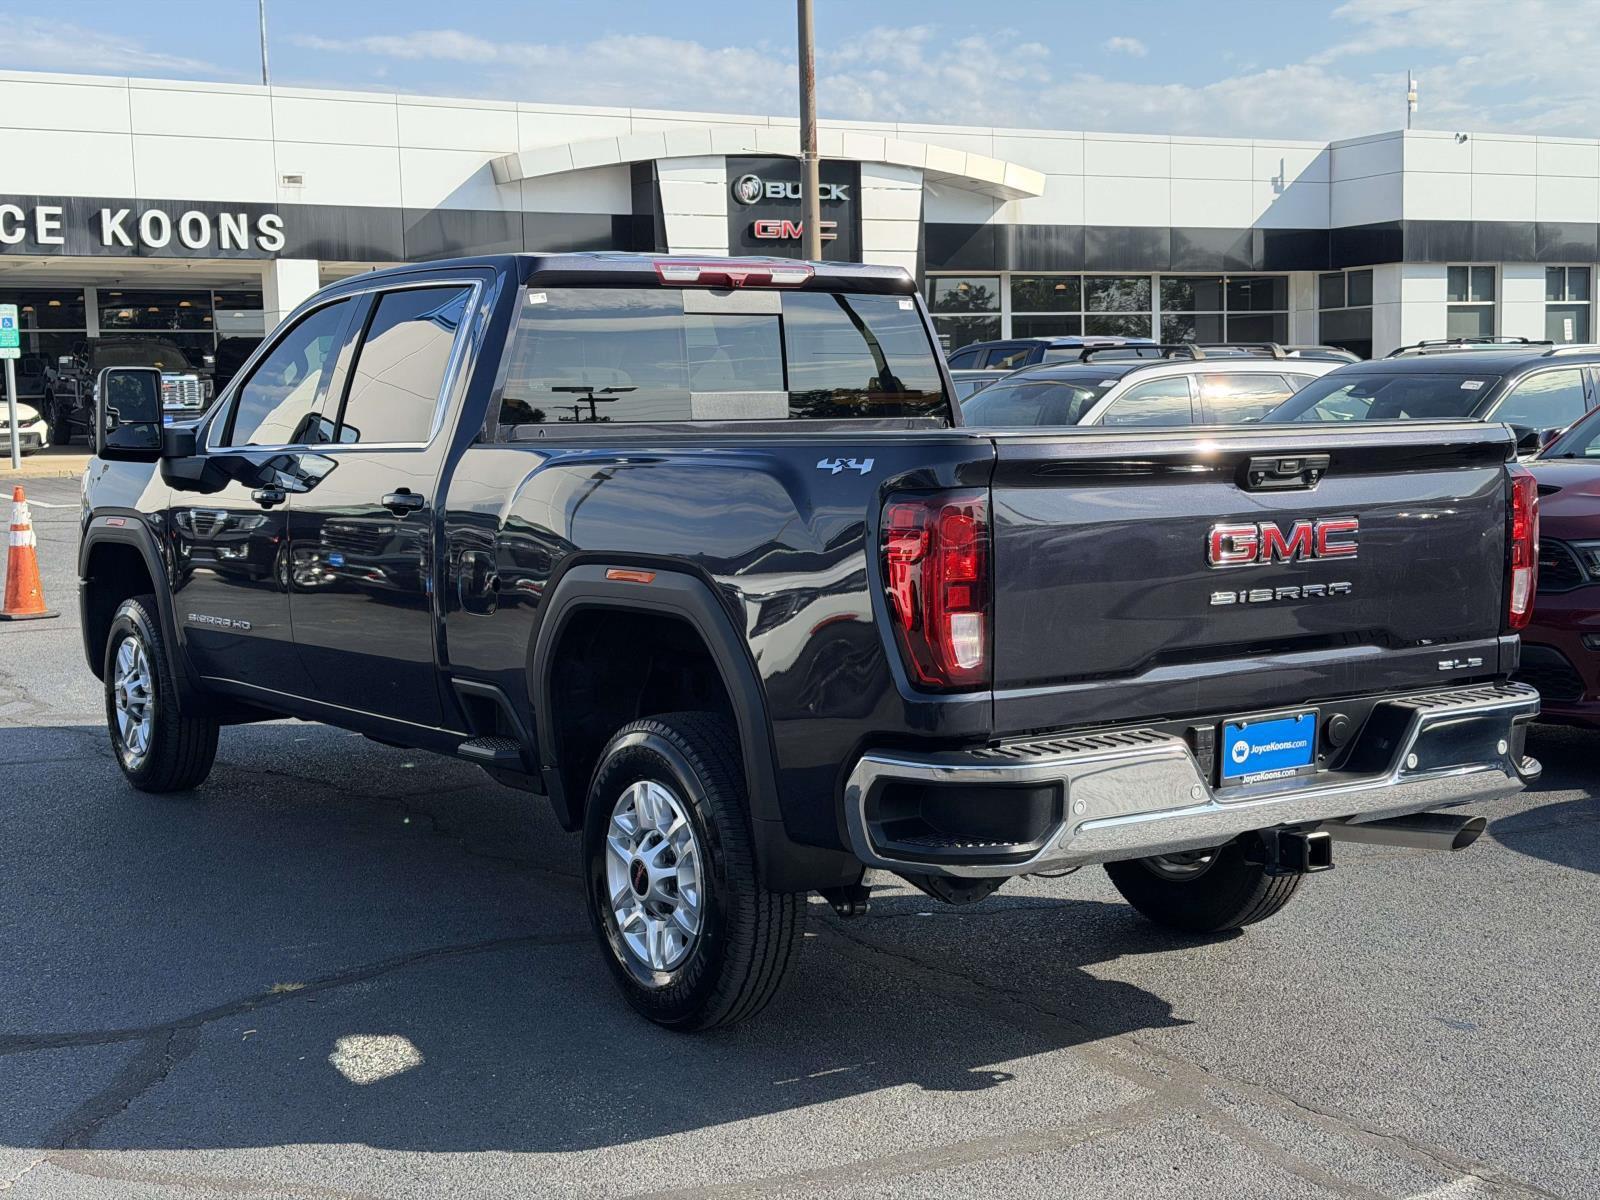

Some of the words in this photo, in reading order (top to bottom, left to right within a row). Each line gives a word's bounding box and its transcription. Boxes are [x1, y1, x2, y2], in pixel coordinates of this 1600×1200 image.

[765, 182, 849, 200] BUCK
[101, 208, 286, 252] KOONS
[1208, 515, 1359, 569] GMC
[1210, 581, 1352, 606] SIERRA
[188, 613, 231, 626] SIERRA
[1250, 739, 1308, 756] JoyceKoons.com
[1242, 768, 1296, 785] JoyceKoons.com
